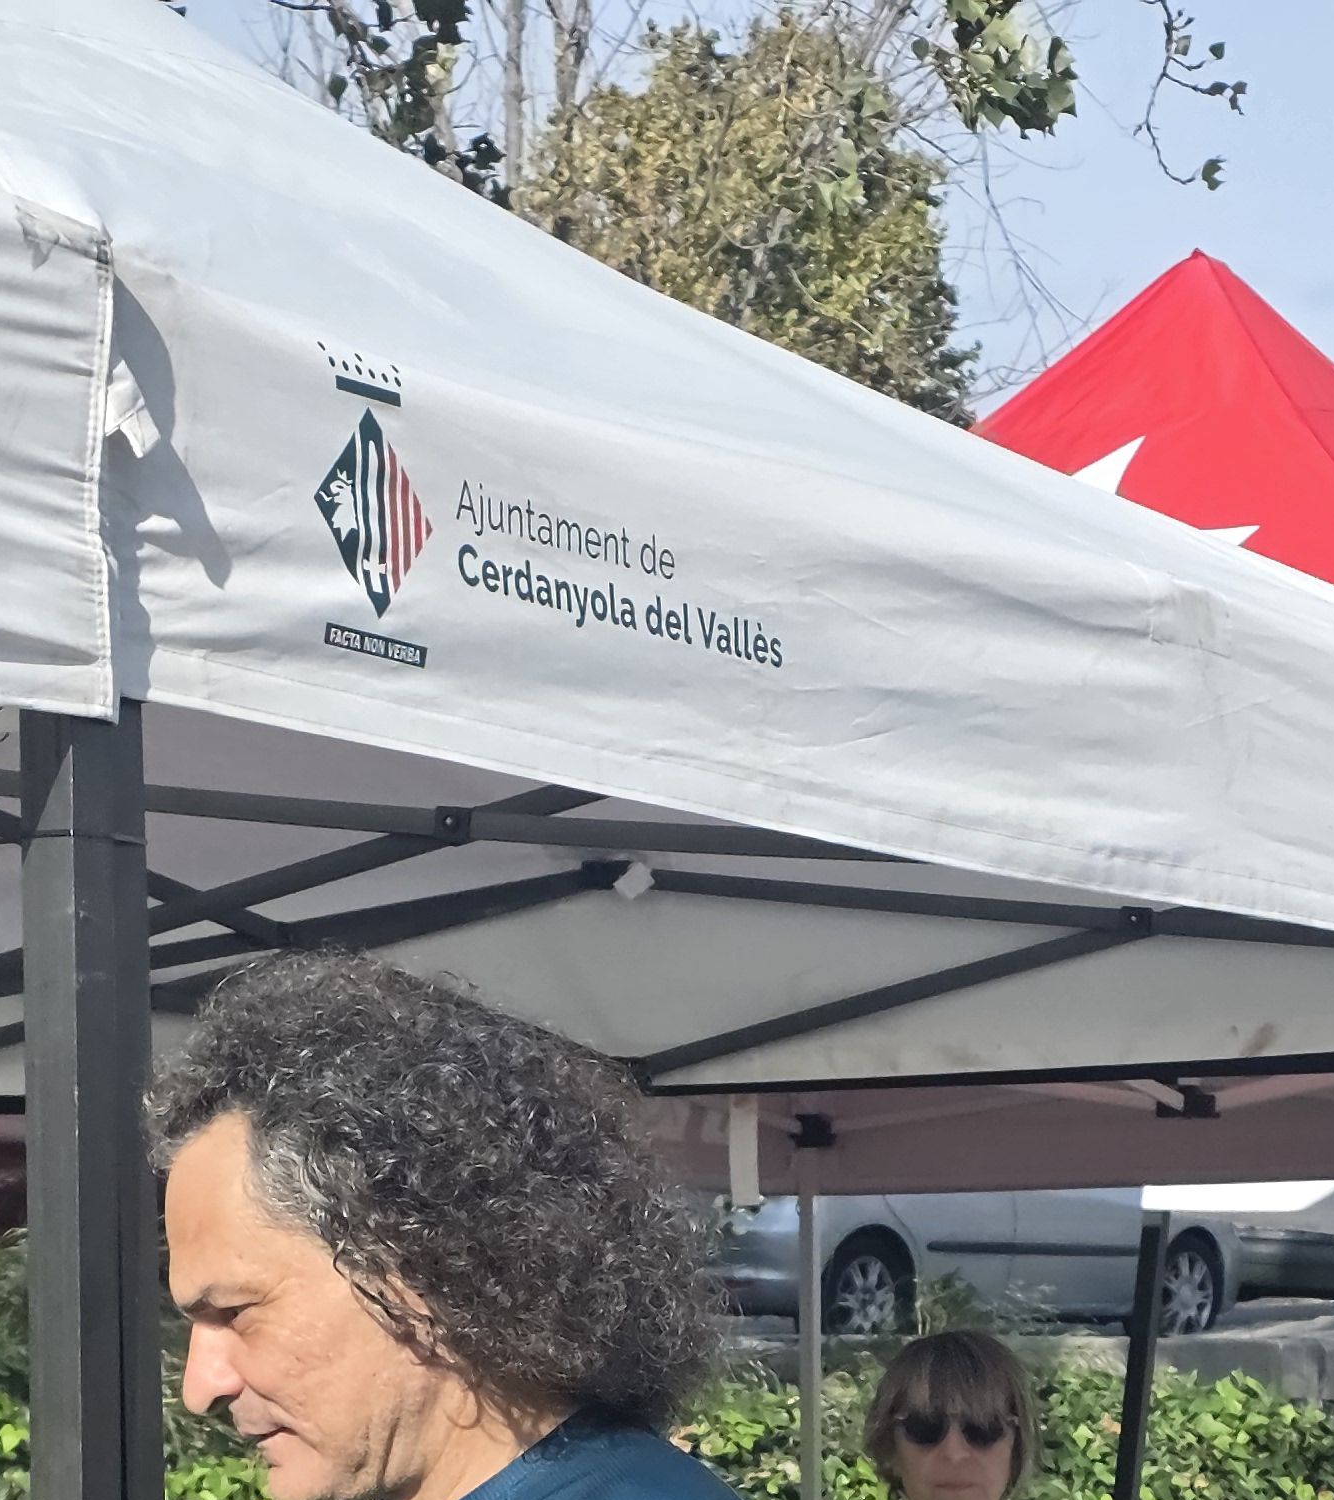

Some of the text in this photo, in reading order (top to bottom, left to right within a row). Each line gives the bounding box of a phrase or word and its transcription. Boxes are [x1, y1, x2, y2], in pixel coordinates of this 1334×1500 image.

[456, 480, 675, 580] Ajuntament de
[330, 628, 420, 664] FACTA NON VERBA
[458, 544, 783, 668] Cerdanyola del Vallès
